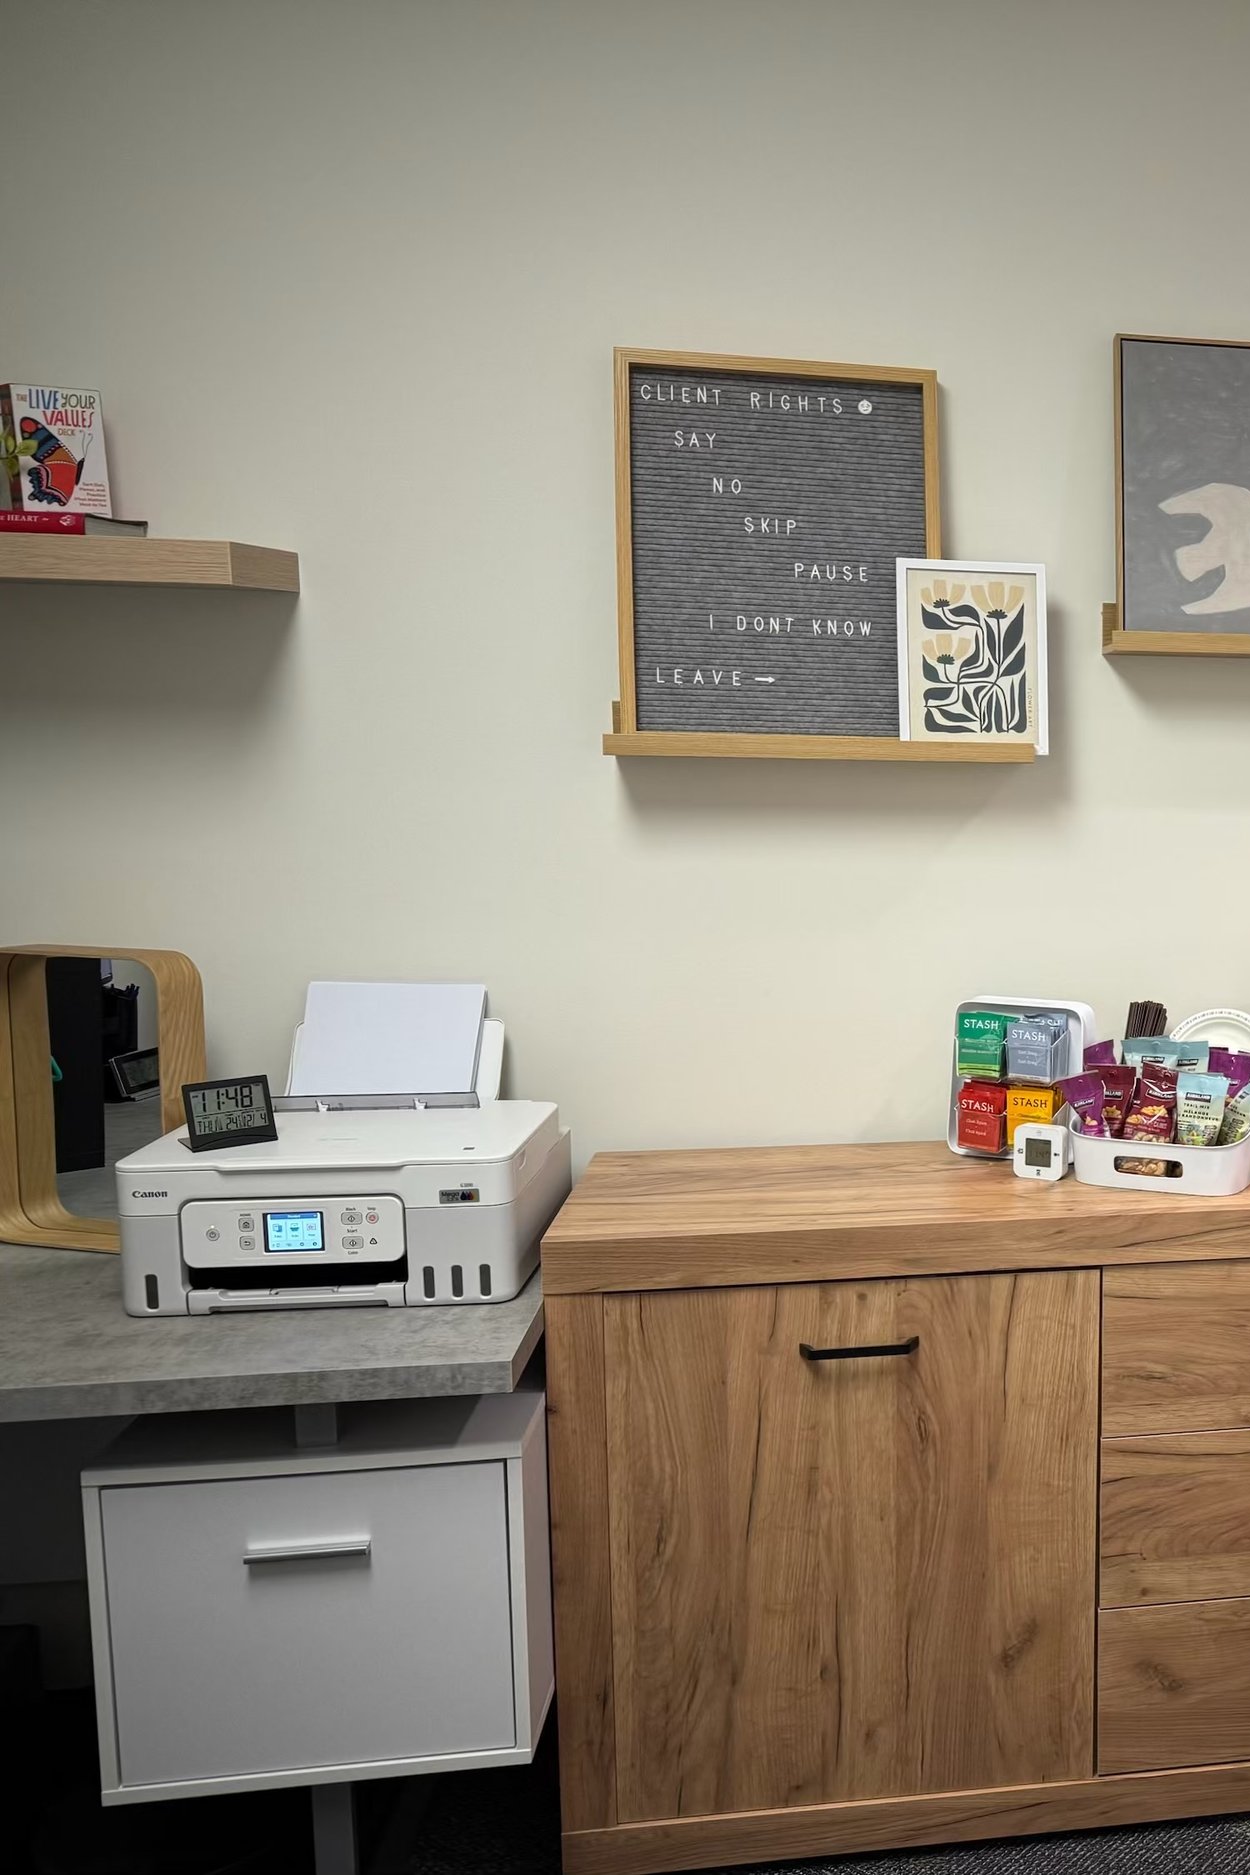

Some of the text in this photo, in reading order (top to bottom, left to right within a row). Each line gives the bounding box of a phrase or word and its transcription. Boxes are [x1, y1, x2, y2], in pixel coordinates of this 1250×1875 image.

[28, 388, 60, 410] LIVE
[61, 393, 96, 409] YOUR
[640, 384, 843, 415] CLIENT RIGHTS
[42, 409, 95, 428] VALUES
[57, 428, 76, 437] DECK
[674, 431, 717, 449] SAY
[713, 477, 742, 495] NO
[7, 514, 39, 522] HEART
[744, 517, 797, 536] SKIP
[794, 563, 869, 582] PAUSE
[709, 614, 872, 637] I DONT KNOW
[656, 667, 742, 686] LEAVE
[963, 1019, 999, 1030] STASH
[1011, 1030, 1046, 1042] STASH
[202, 1085, 254, 1113] 11:48
[961, 1099, 994, 1113] STASH
[1012, 1097, 1048, 1109] STASH
[131, 1190, 168, 1199] Canon
